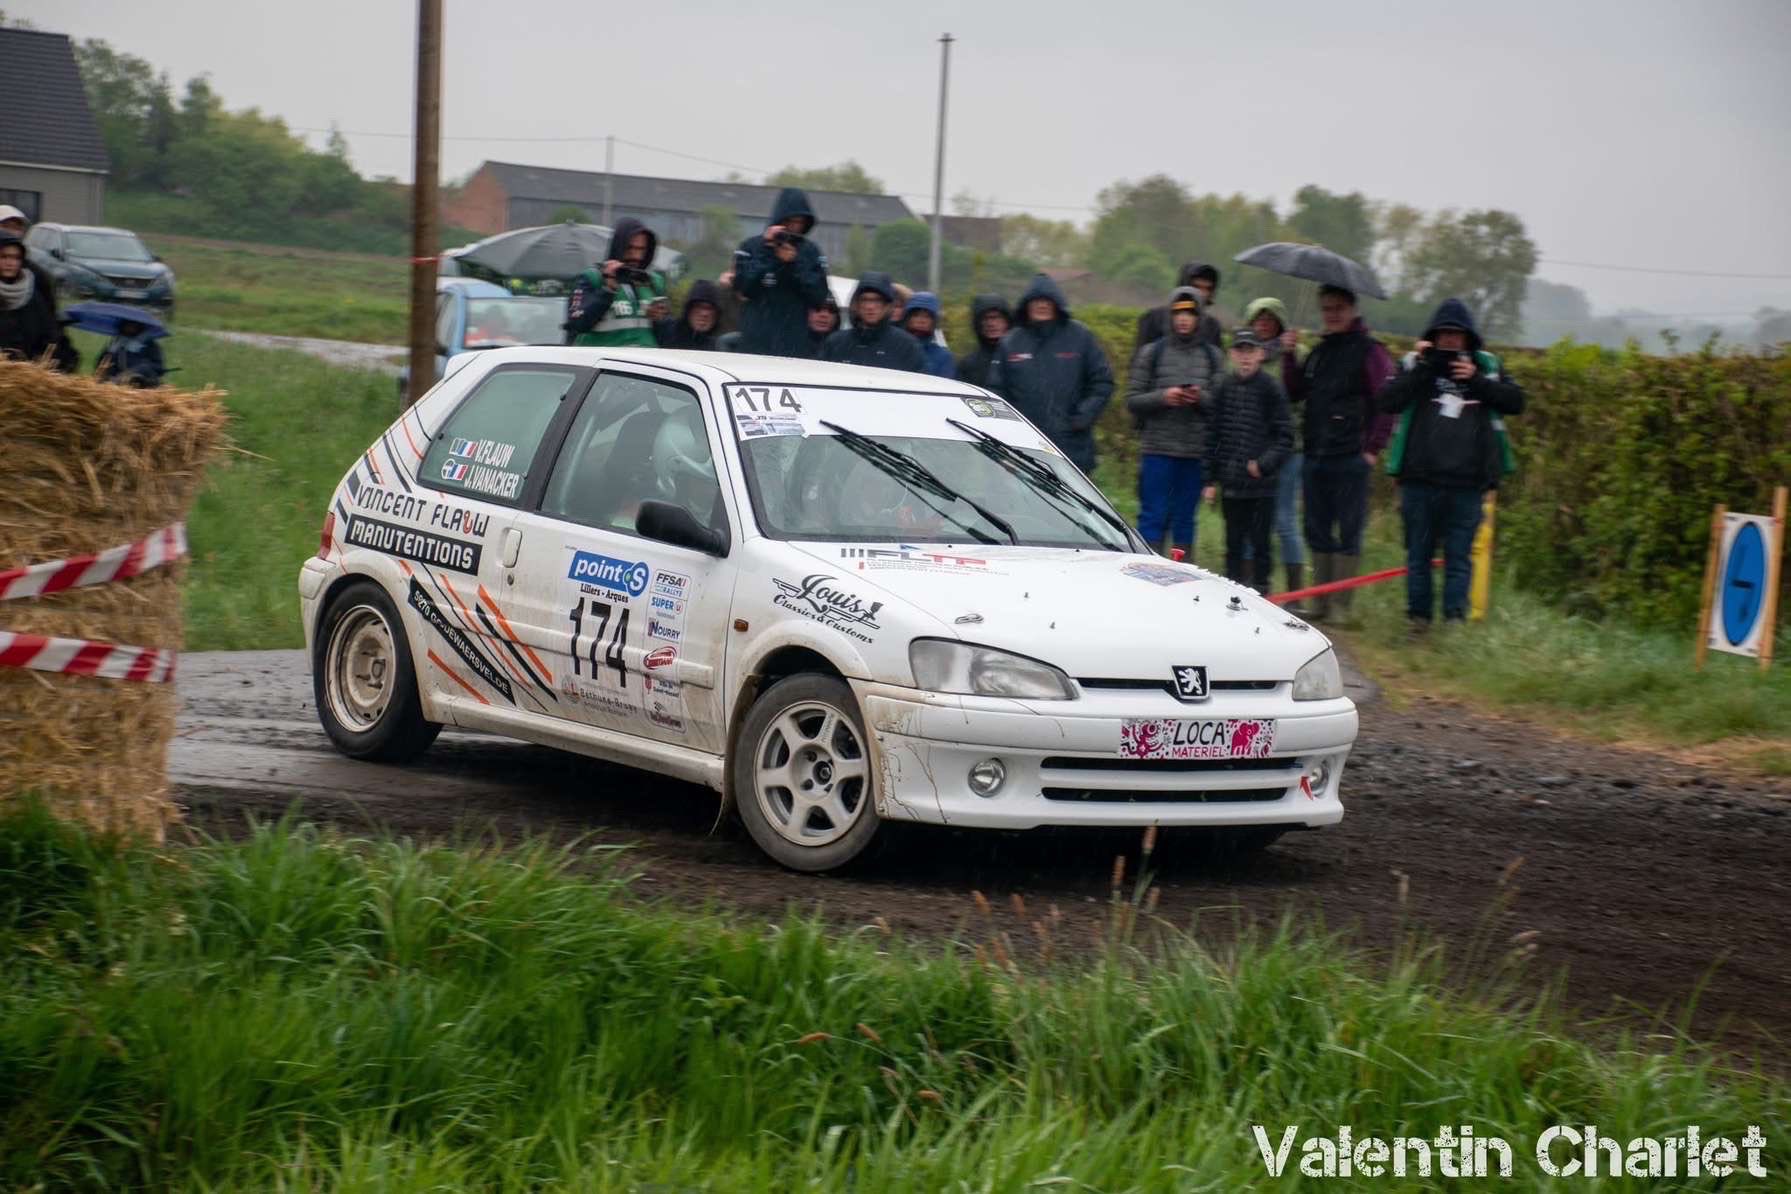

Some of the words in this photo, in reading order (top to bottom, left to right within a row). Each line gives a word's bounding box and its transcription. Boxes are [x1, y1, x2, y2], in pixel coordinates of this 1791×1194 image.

[735, 388, 802, 413] 174
[463, 464, 520, 498] J.VANACKER
[350, 520, 473, 569] MANUTENTIONS
[574, 559, 623, 582] point
[629, 567, 646, 591] S
[656, 572, 682, 587] FFSA
[580, 583, 600, 596] Lillers
[605, 589, 629, 603] Arques
[651, 596, 675, 610] SUPER
[797, 574, 864, 613] Louis
[569, 597, 630, 688] 174
[1172, 721, 1226, 745] LOCA
[1171, 746, 1224, 758] MATERIEL
